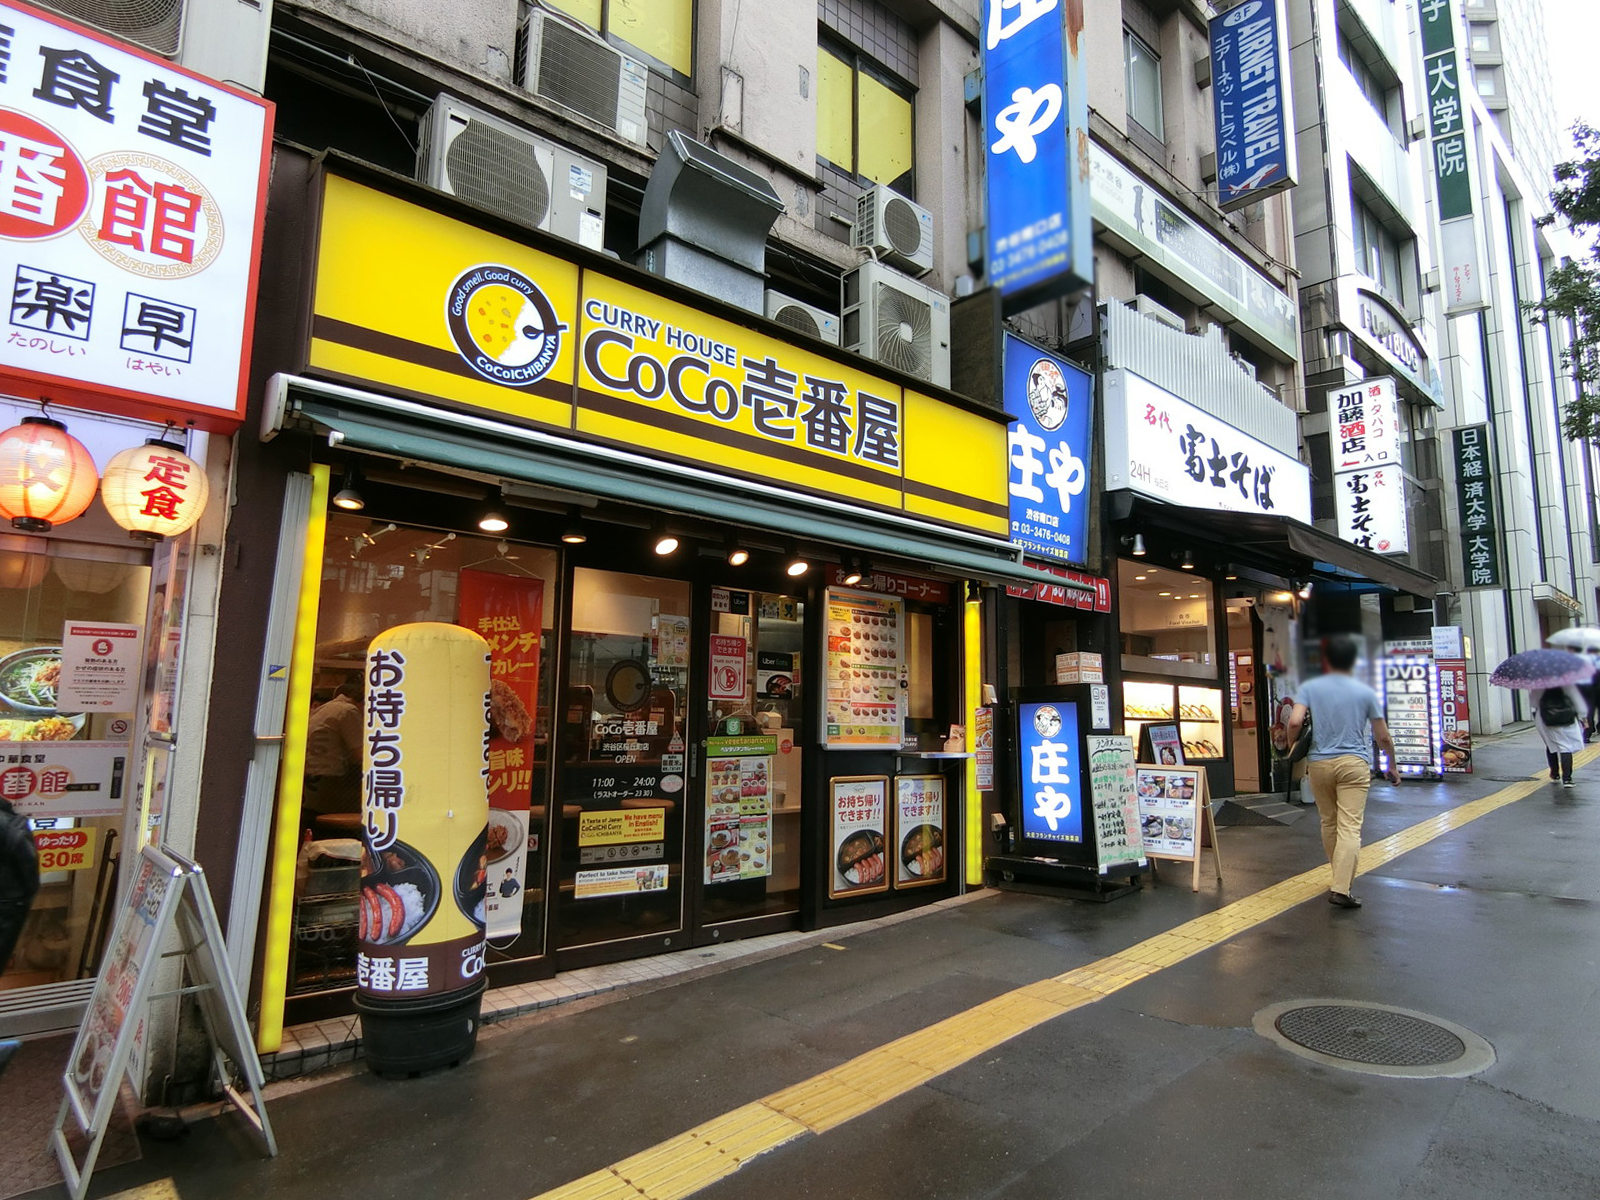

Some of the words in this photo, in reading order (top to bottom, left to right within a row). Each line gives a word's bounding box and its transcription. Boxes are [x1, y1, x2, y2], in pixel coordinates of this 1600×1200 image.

[1233, 5, 1252, 22] 3F
[1238, 16, 1276, 91] AIRNET
[1242, 84, 1281, 169] TRAVEL
[1428, 58, 1465, 178] 大学院
[452, 287, 467, 316] Good
[484, 270, 510, 281] Good
[510, 275, 535, 296] curry
[123, 302, 191, 351] 早
[585, 300, 661, 340] CURRY
[666, 324, 737, 367] HOUSE
[7, 331, 87, 356] たのしい
[126, 357, 182, 376] はやい
[1144, 403, 1173, 433] 名代
[1337, 391, 1366, 455] 加藤酒店
[1179, 423, 1276, 511] 富士そば
[1364, 451, 1388, 463] 入口
[1130, 460, 1151, 484] 24H
[1461, 428, 1487, 531] 日本経済大学
[140, 455, 192, 521] 定食
[1026, 508, 1060, 528] 渋谷南口店
[1346, 473, 1377, 551] 富士そば
[1469, 535, 1492, 585] 大学院
[836, 569, 941, 598] お帰りコーナー
[478, 616, 521, 633] 手仕込
[488, 631, 539, 655] メンチ
[492, 658, 535, 676] カレー
[762, 657, 776, 666] Uber
[1386, 665, 1426, 680] DVD
[366, 650, 405, 848] お持ち帰り
[489, 747, 524, 770] 旨味
[615, 755, 637, 764] OPEN
[592, 777, 615, 787] 11:00
[633, 776, 656, 787] 24:00
[1031, 739, 1072, 831] 庄や
[837, 793, 880, 809] お持ち帰り
[902, 791, 940, 805] お持ち帰り
[838, 808, 881, 822] できます!!
[902, 804, 940, 817] できます!!
[38, 835, 79, 847] ゆったり
[41, 851, 84, 868] 30席
[578, 871, 599, 879] Perfect
